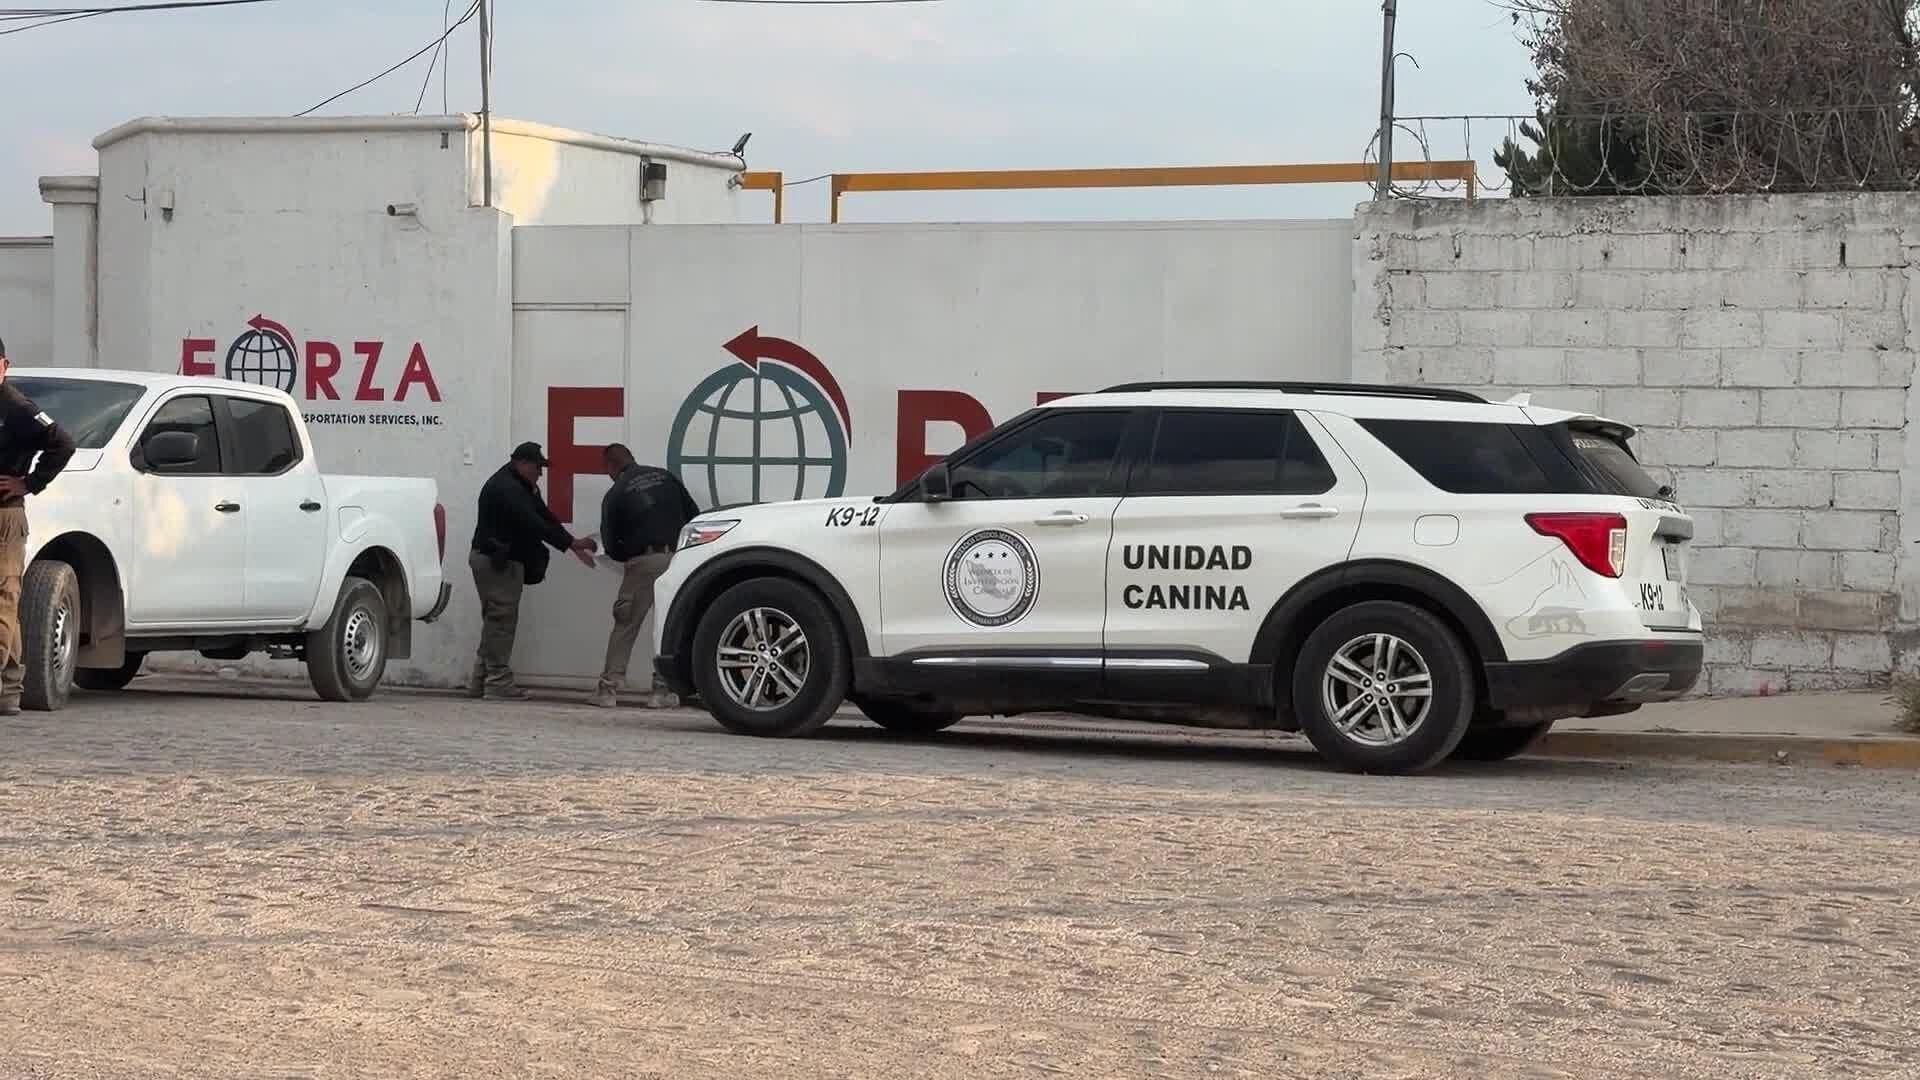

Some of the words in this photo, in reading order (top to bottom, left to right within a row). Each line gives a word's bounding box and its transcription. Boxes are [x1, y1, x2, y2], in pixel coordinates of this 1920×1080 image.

[302, 413, 366, 425] SPORTATION
[369, 414, 419, 426] SERVICES,
[422, 415, 444, 426] INC.
[825, 506, 880, 527] K9-12
[1123, 544, 1252, 570] UNIDAD
[1123, 584, 1250, 610] CANINA
[1640, 583, 1665, 611] K9-12
